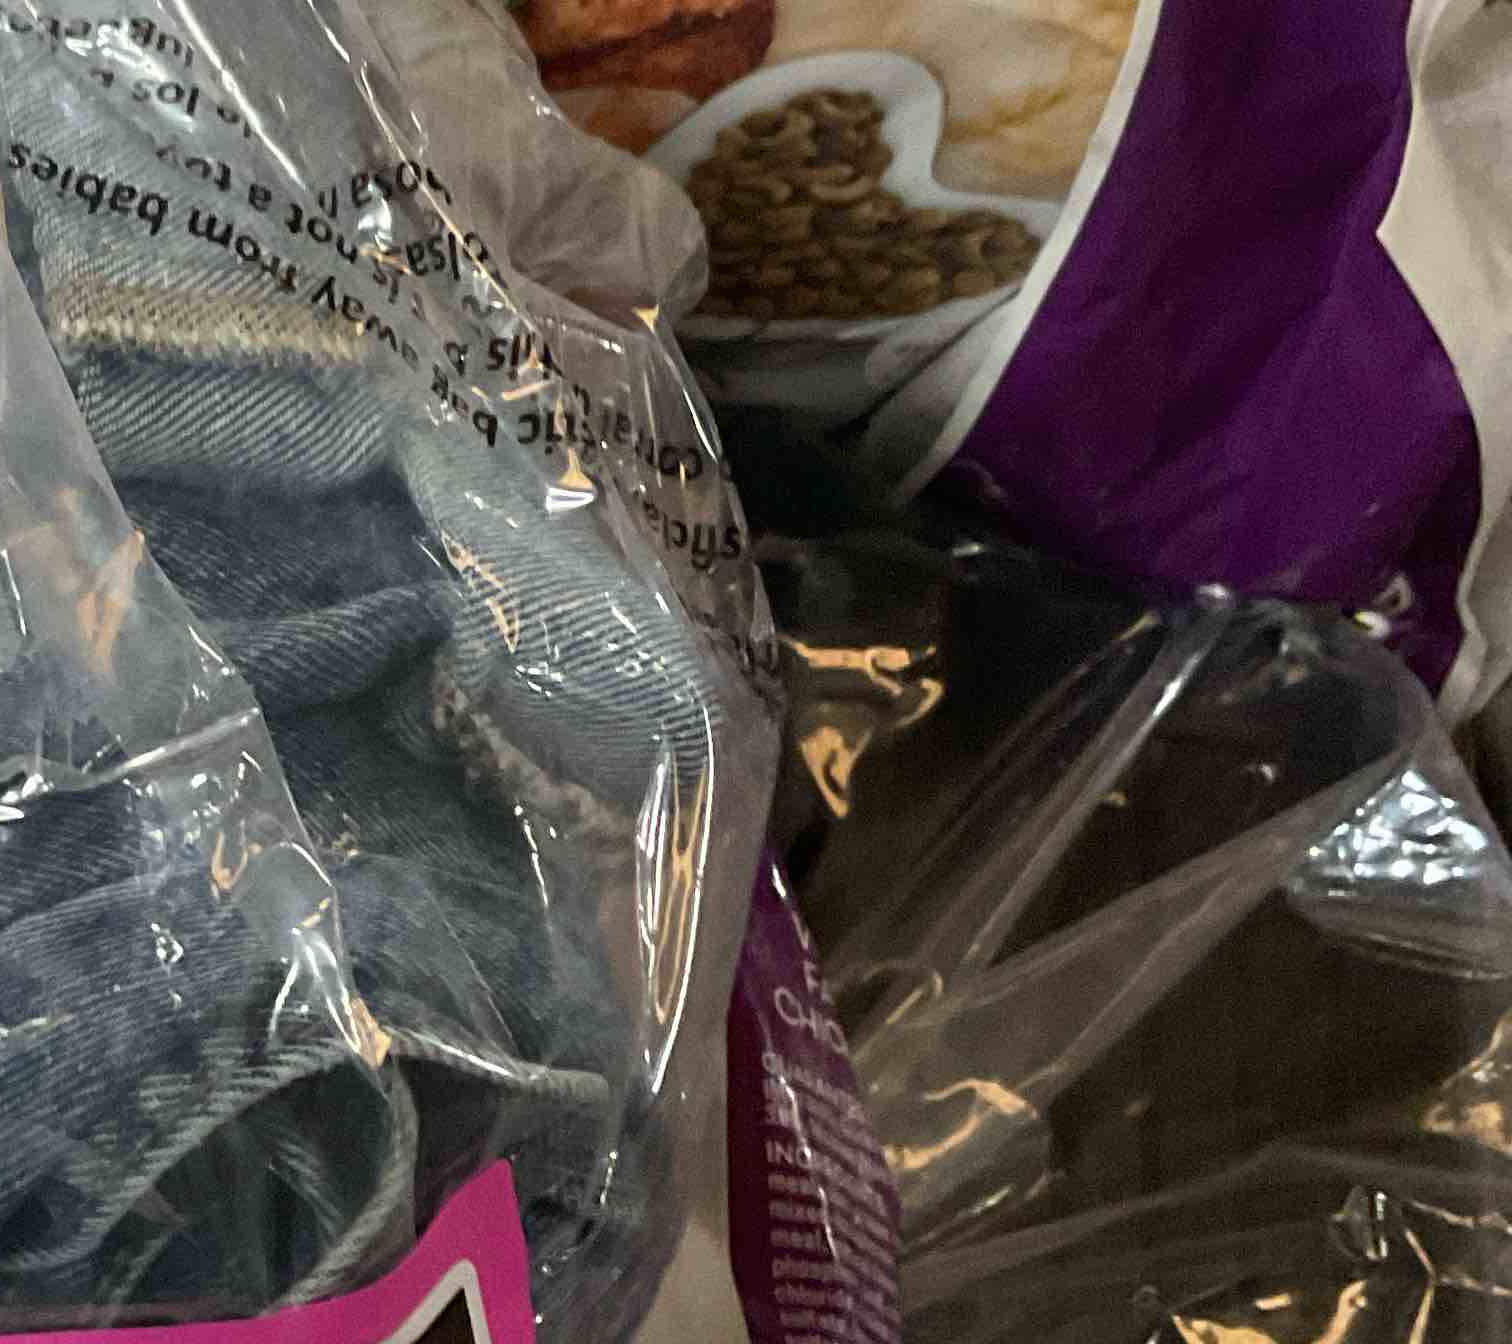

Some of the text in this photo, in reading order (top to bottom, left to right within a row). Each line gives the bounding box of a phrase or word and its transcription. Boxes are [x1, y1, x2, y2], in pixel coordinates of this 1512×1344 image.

[8, 138, 170, 240] babies
[247, 183, 273, 213] a
[282, 198, 358, 268] not
